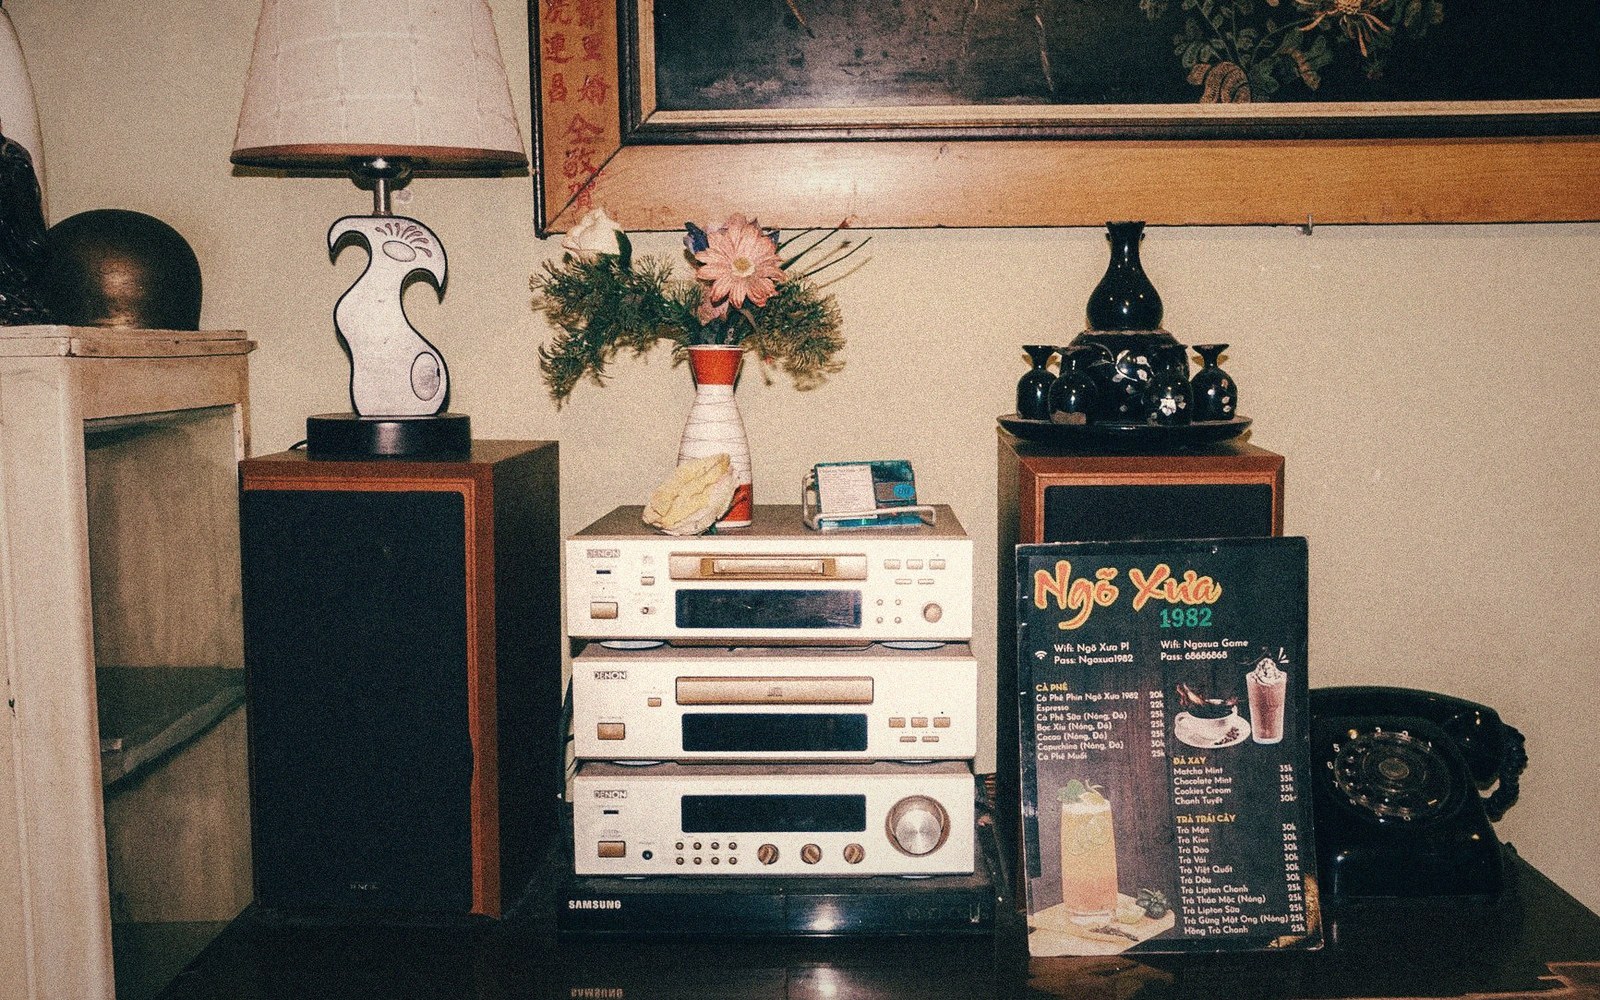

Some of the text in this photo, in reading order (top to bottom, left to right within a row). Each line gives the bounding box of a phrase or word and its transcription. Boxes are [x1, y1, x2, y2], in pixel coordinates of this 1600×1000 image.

[587, 549, 620, 558] DENON
[1034, 560, 1222, 630] Ngõ Xưa
[1160, 608, 1212, 628] 1982
[1054, 644, 1074, 653] Wifi:
[1077, 644, 1096, 654] Ngõ
[1100, 642, 1117, 652] Xưa
[1161, 639, 1248, 650] Wifi: Ngoxua Game
[1054, 655, 1133, 666] Pass: Ngoxua1982
[1161, 651, 1228, 661] Pass: 68686868
[594, 671, 627, 679] DENON
[1036, 704, 1069, 712] Espresso
[1333, 743, 1340, 752] 5
[1174, 767, 1202, 775] Matcha
[1280, 764, 1293, 772] 35k
[1174, 777, 1212, 785] Chocolate
[594, 790, 627, 798] DENON
[1174, 787, 1204, 795] Cookies
[1206, 786, 1231, 794] Cream
[1284, 843, 1298, 851] 30k
[1196, 886, 1221, 895] Lipton
[1223, 885, 1248, 893] Chanh
[1288, 893, 1302, 901] 25k
[569, 900, 621, 909] SAMSUNG
[1198, 906, 1222, 915] Lipton
[1240, 915, 1258, 924] Ong
[1290, 914, 1304, 922] 25k
[1223, 926, 1248, 934] Chanh
[1291, 924, 1305, 932] 25k
